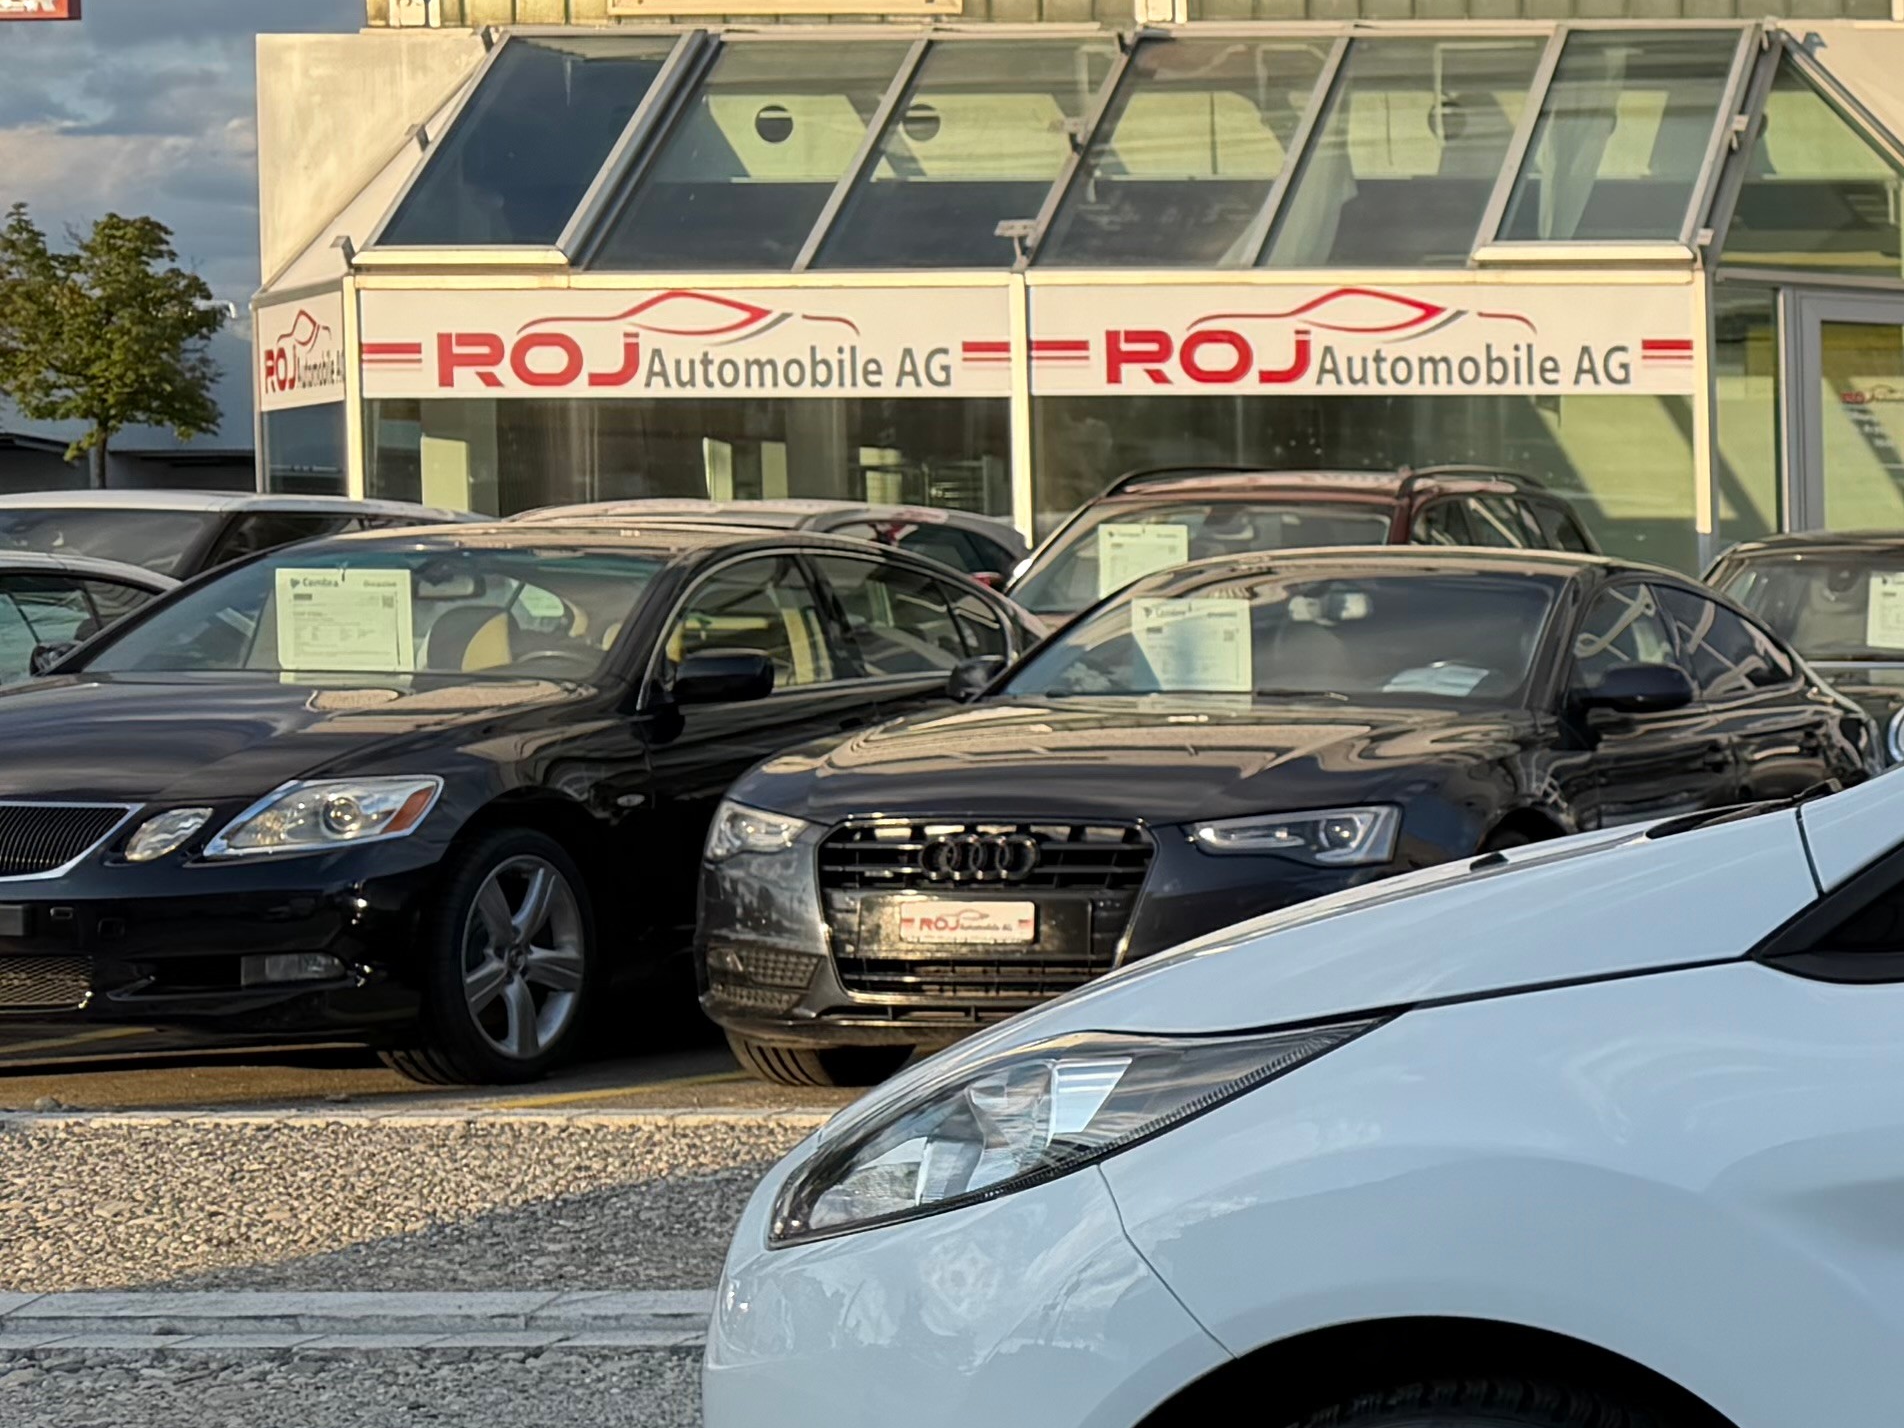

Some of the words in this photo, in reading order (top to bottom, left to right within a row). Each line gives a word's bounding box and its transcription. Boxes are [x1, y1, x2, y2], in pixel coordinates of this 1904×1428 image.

[437, 332, 641, 388] ROJ
[645, 346, 883, 389] Automobile
[895, 347, 951, 388] AG
[1104, 329, 1311, 385] ROJ
[1316, 342, 1560, 386] Automobile
[1572, 345, 1632, 385] AG
